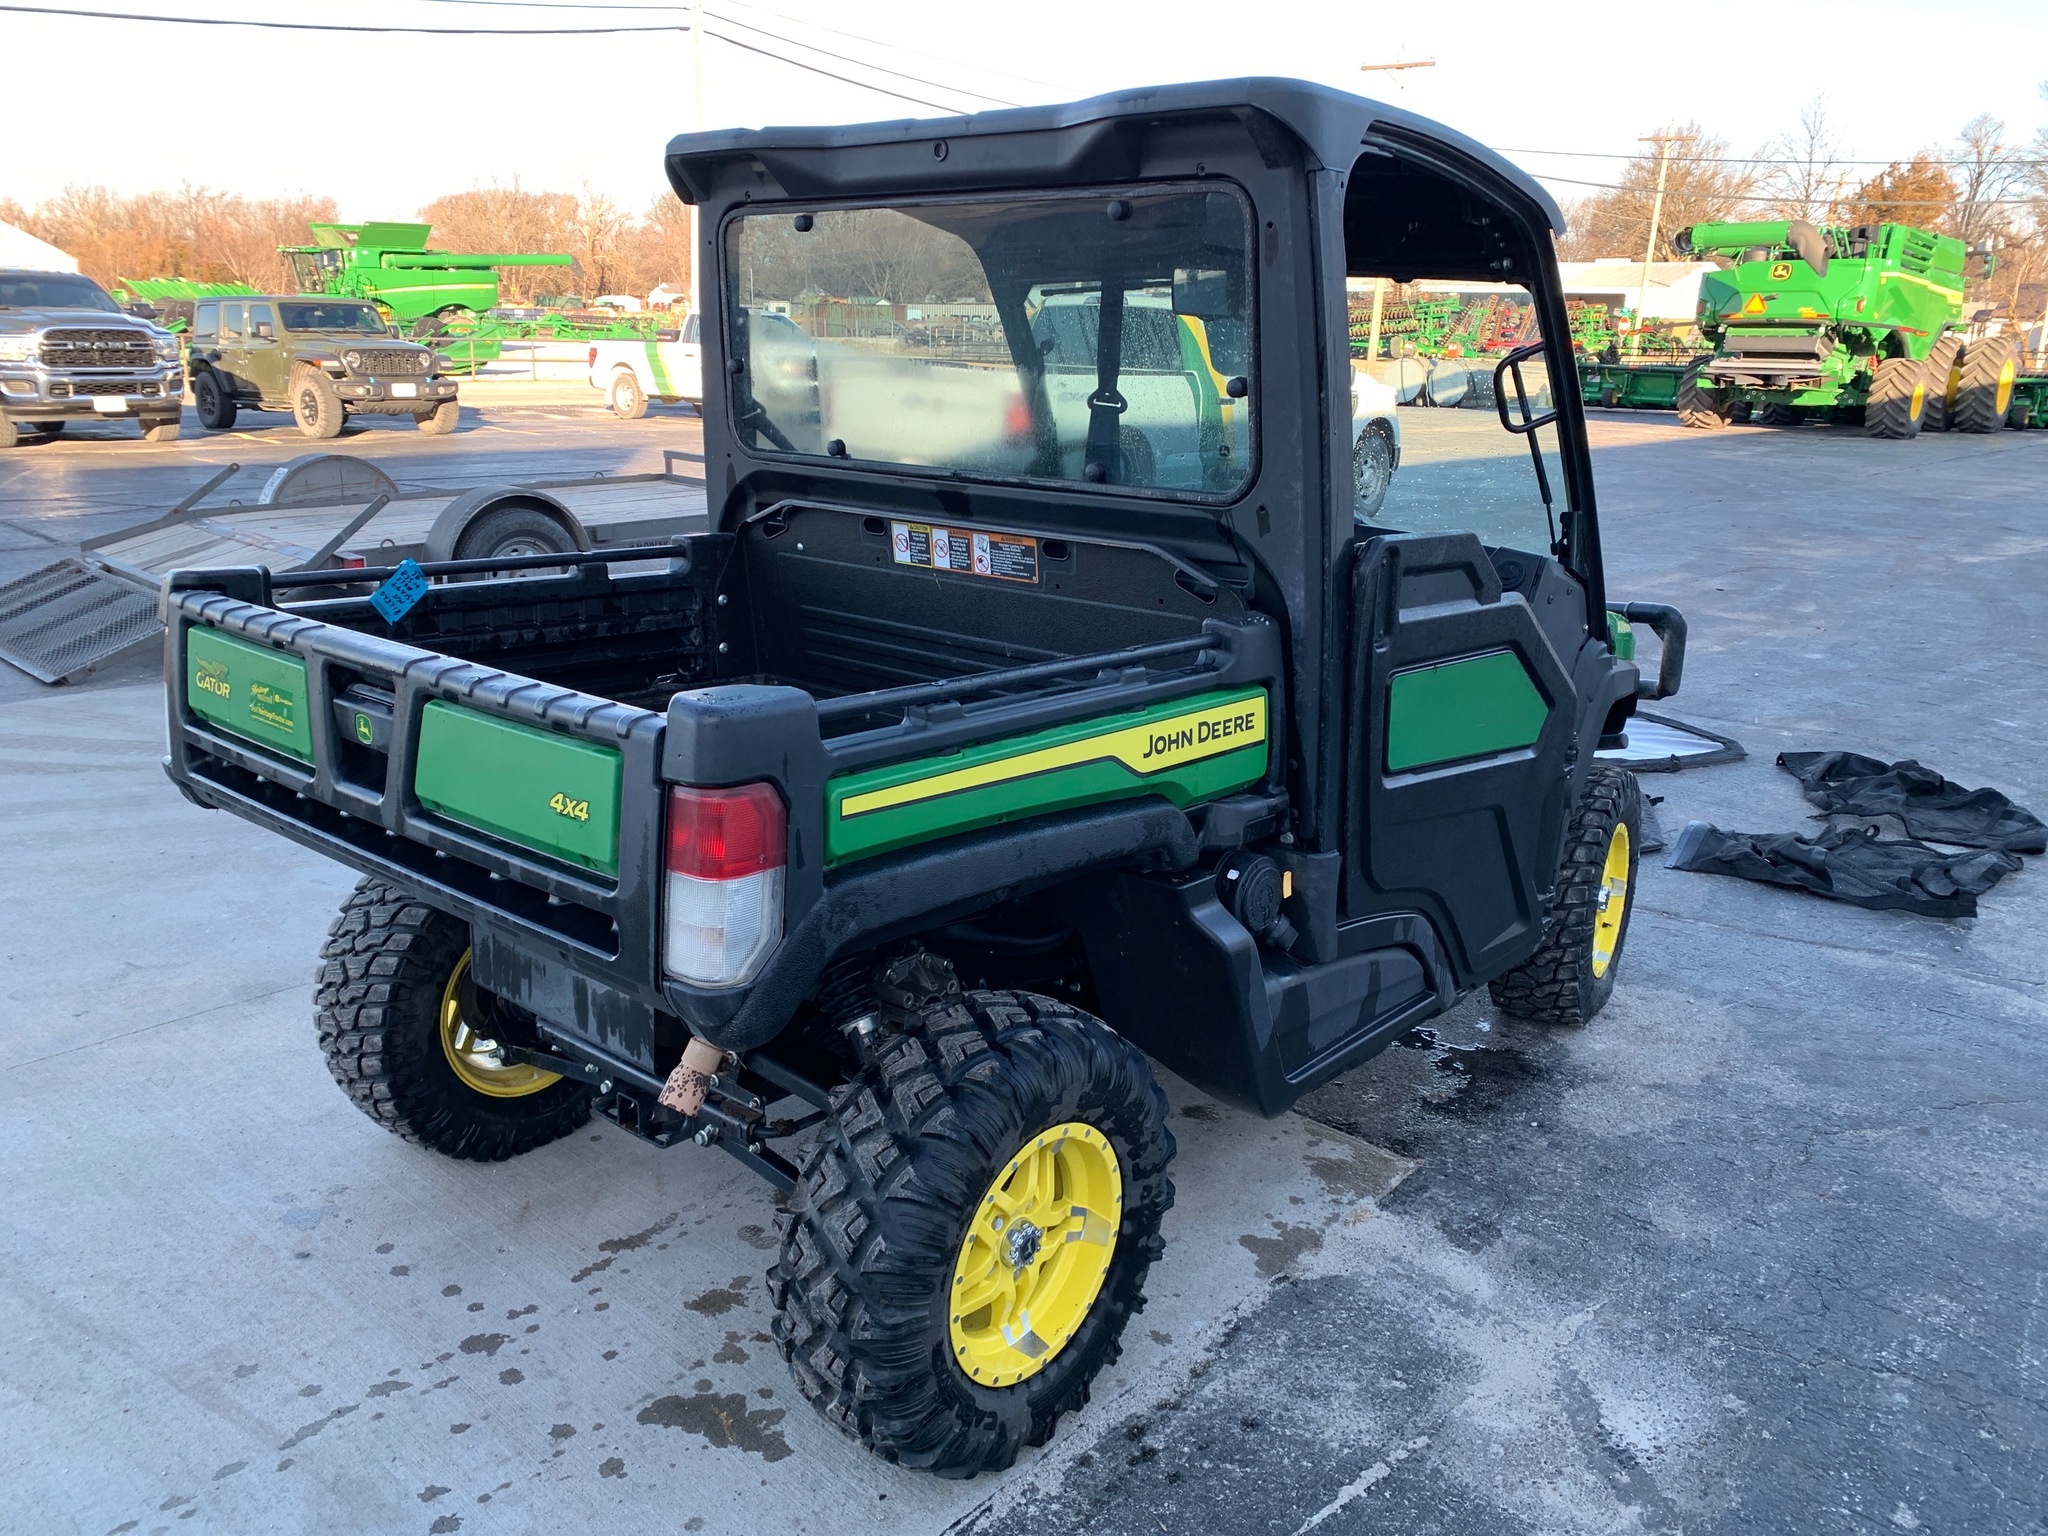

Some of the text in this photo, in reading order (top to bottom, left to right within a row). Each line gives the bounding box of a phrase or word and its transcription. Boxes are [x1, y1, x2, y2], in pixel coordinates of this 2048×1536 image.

[75, 341, 125, 349] RAM
[196, 671, 231, 699] GATOR
[1143, 712, 1255, 759] JOHN DEERE
